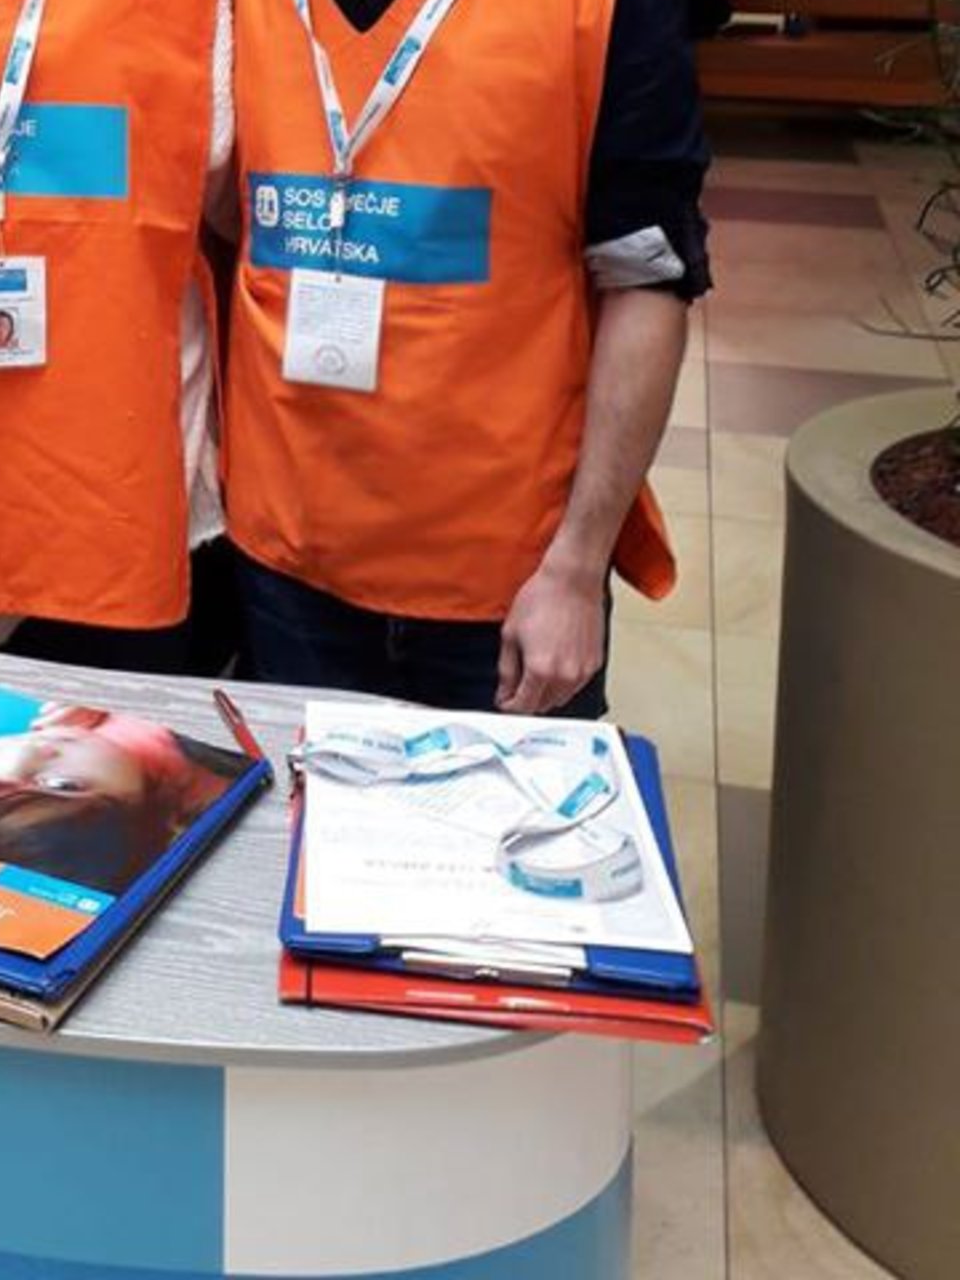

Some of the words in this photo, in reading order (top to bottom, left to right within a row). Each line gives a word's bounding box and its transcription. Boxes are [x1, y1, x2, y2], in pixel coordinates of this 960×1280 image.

[283, 187, 326, 209] SOS
[341, 192, 401, 218] JEČJE
[285, 236, 381, 265] HRVATSKA
